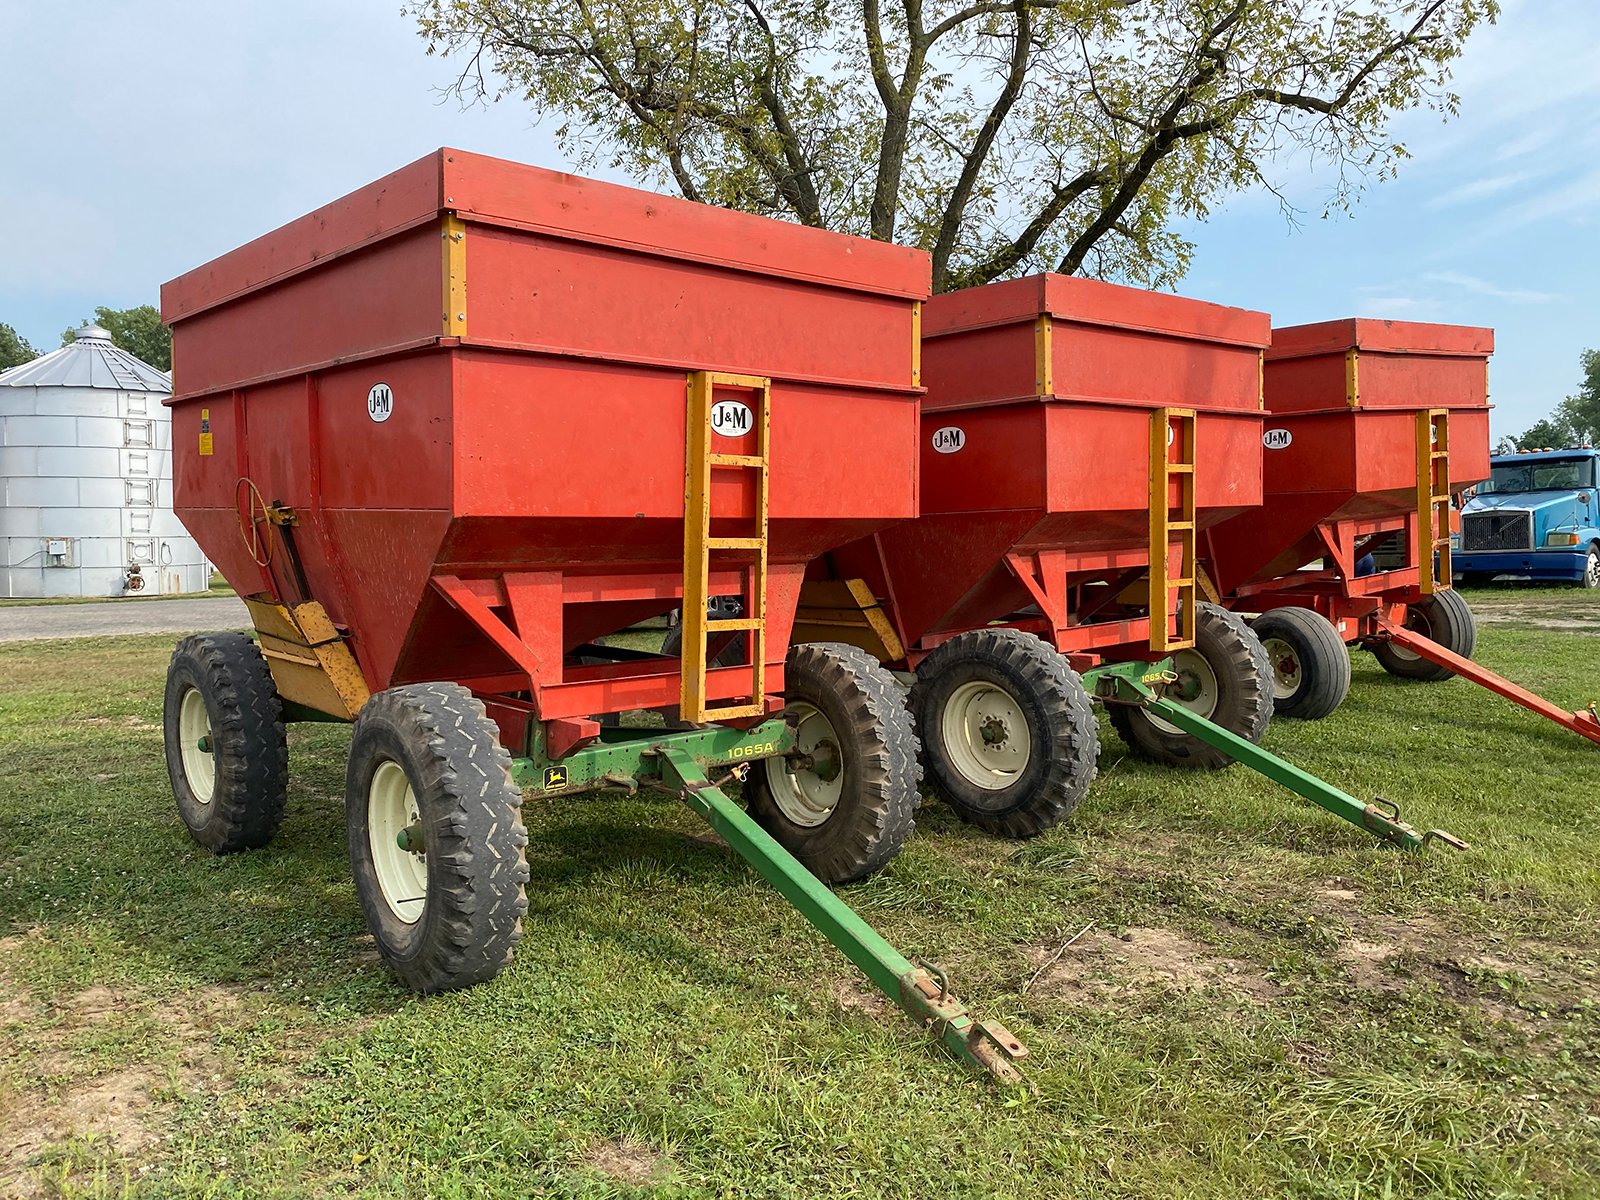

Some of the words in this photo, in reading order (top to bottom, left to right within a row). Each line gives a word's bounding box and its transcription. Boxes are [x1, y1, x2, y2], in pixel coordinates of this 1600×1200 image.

[369, 388, 390, 414] J&M
[712, 405, 747, 429] J&M
[934, 430, 961, 448] J&M
[1264, 431, 1288, 445] J&M
[1141, 672, 1163, 683] 1065
[728, 742, 774, 759] 1065A
